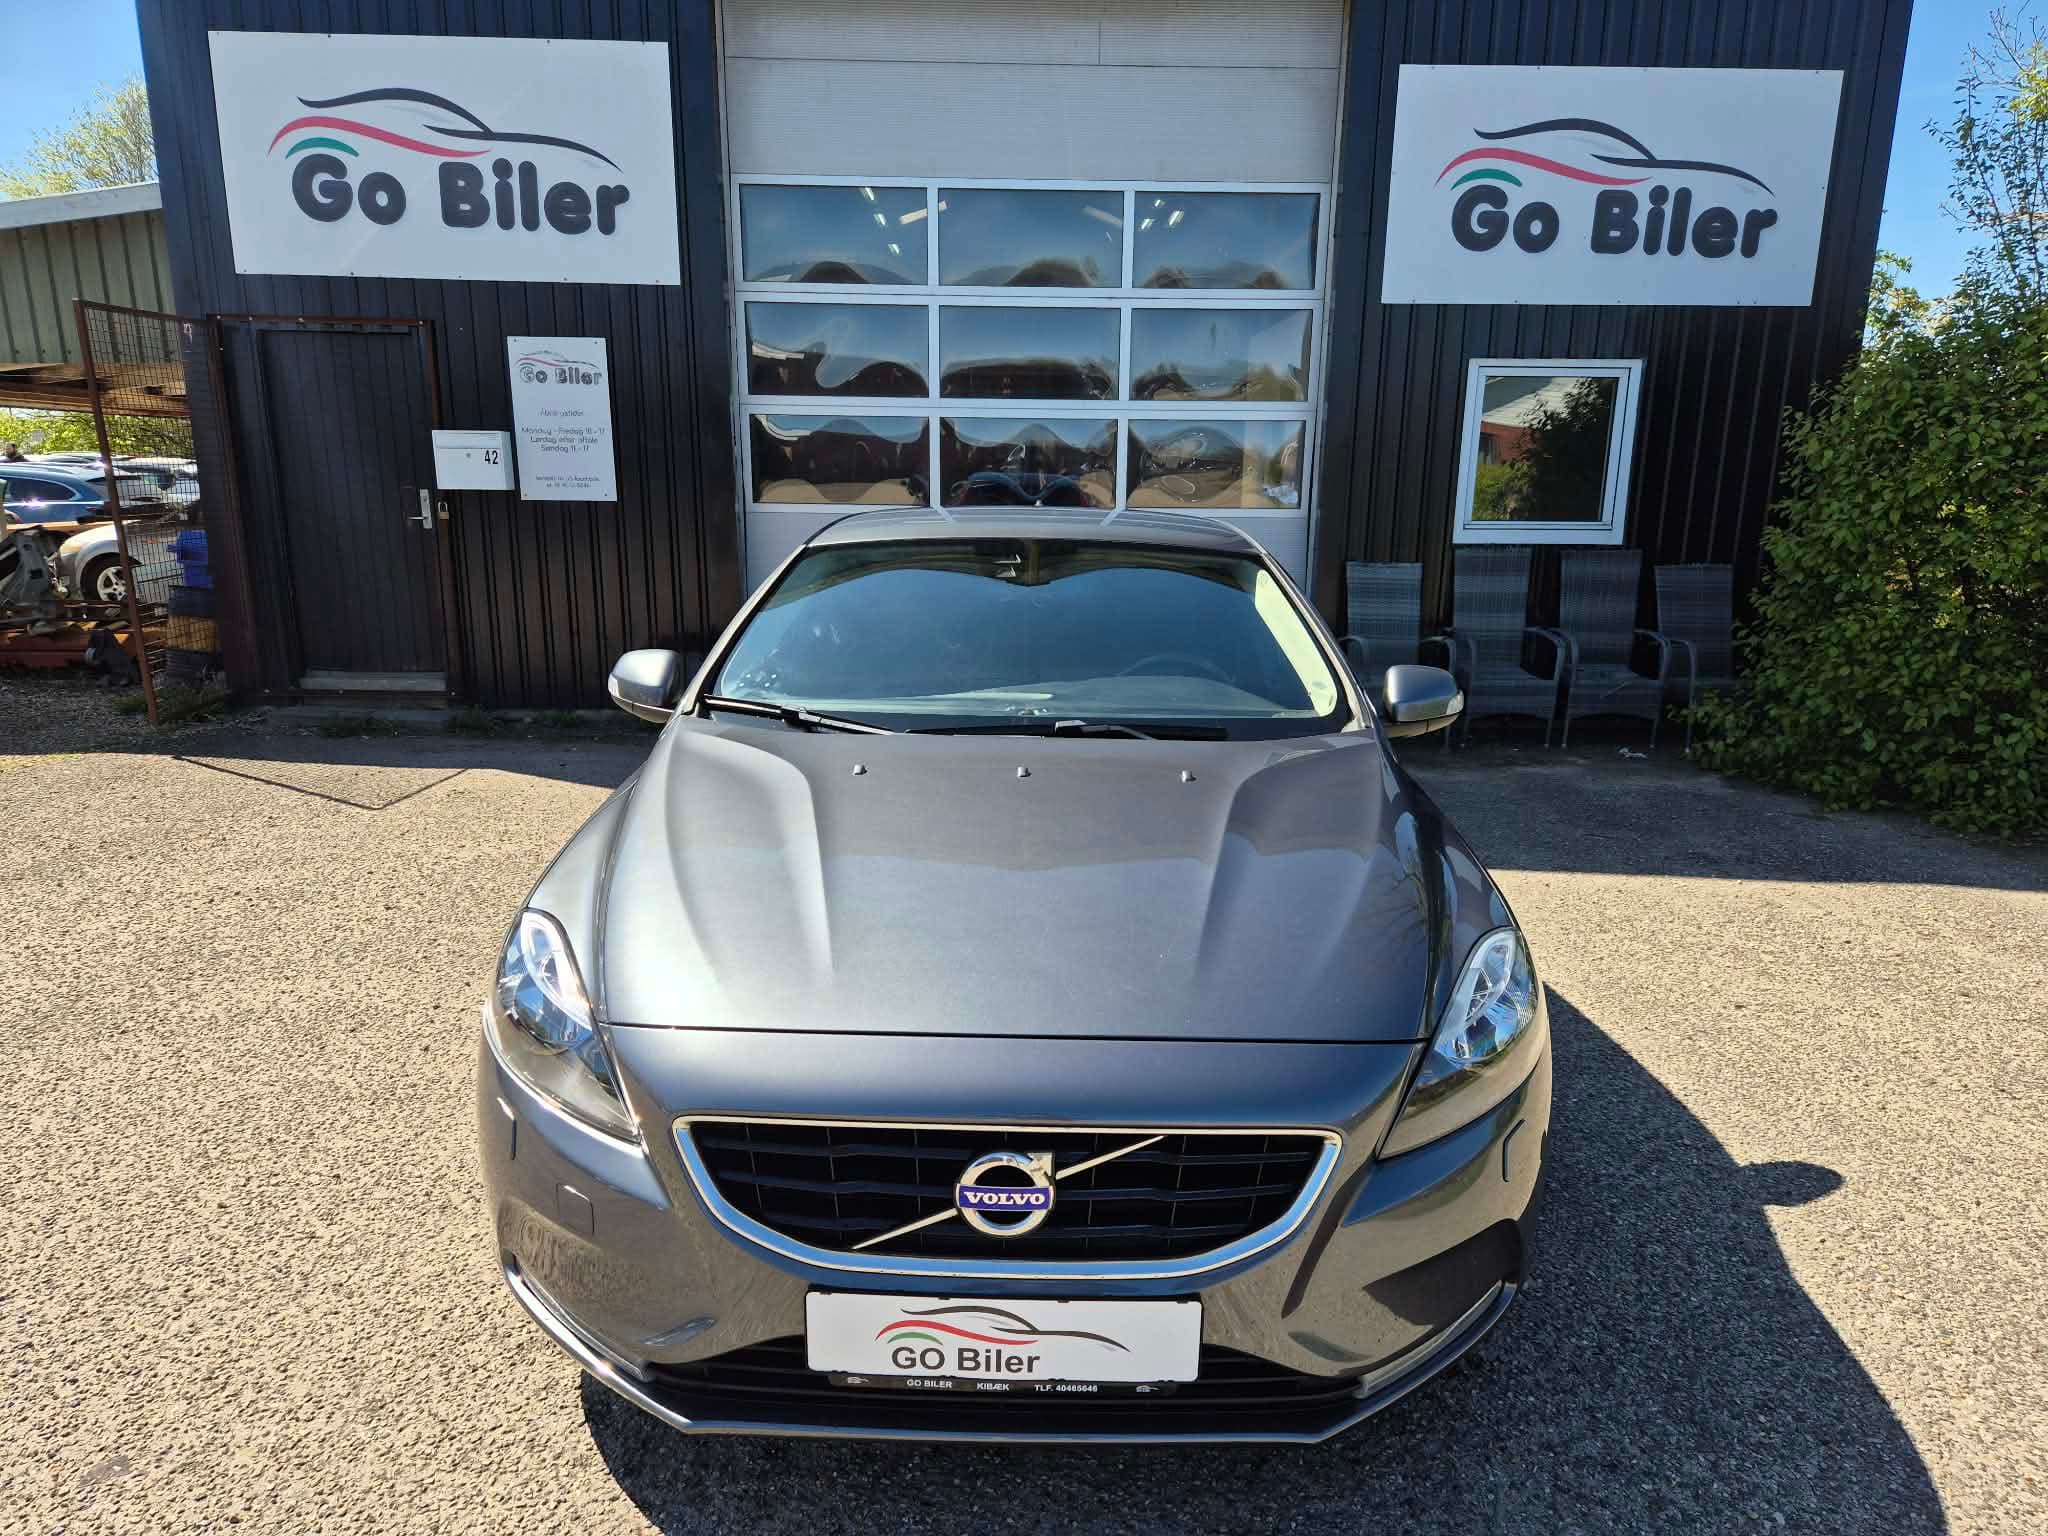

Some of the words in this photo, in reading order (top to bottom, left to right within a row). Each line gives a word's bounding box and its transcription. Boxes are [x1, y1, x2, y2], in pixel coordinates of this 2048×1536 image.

[291, 153, 407, 226] Go
[438, 157, 630, 235] Biler
[1451, 184, 1560, 254] Go
[1591, 184, 1778, 259] Biler
[519, 366, 548, 384] Go
[554, 366, 602, 385] Biler
[484, 449, 499, 465] 42
[963, 1191, 1046, 1205] VOLVO
[891, 1346, 946, 1370] GO
[957, 1346, 1041, 1374] Biler
[906, 1378, 922, 1388] GO
[924, 1380, 953, 1389] BILER
[976, 1383, 1010, 1391] KIBÆK
[1034, 1384, 1054, 1392] TLF.
